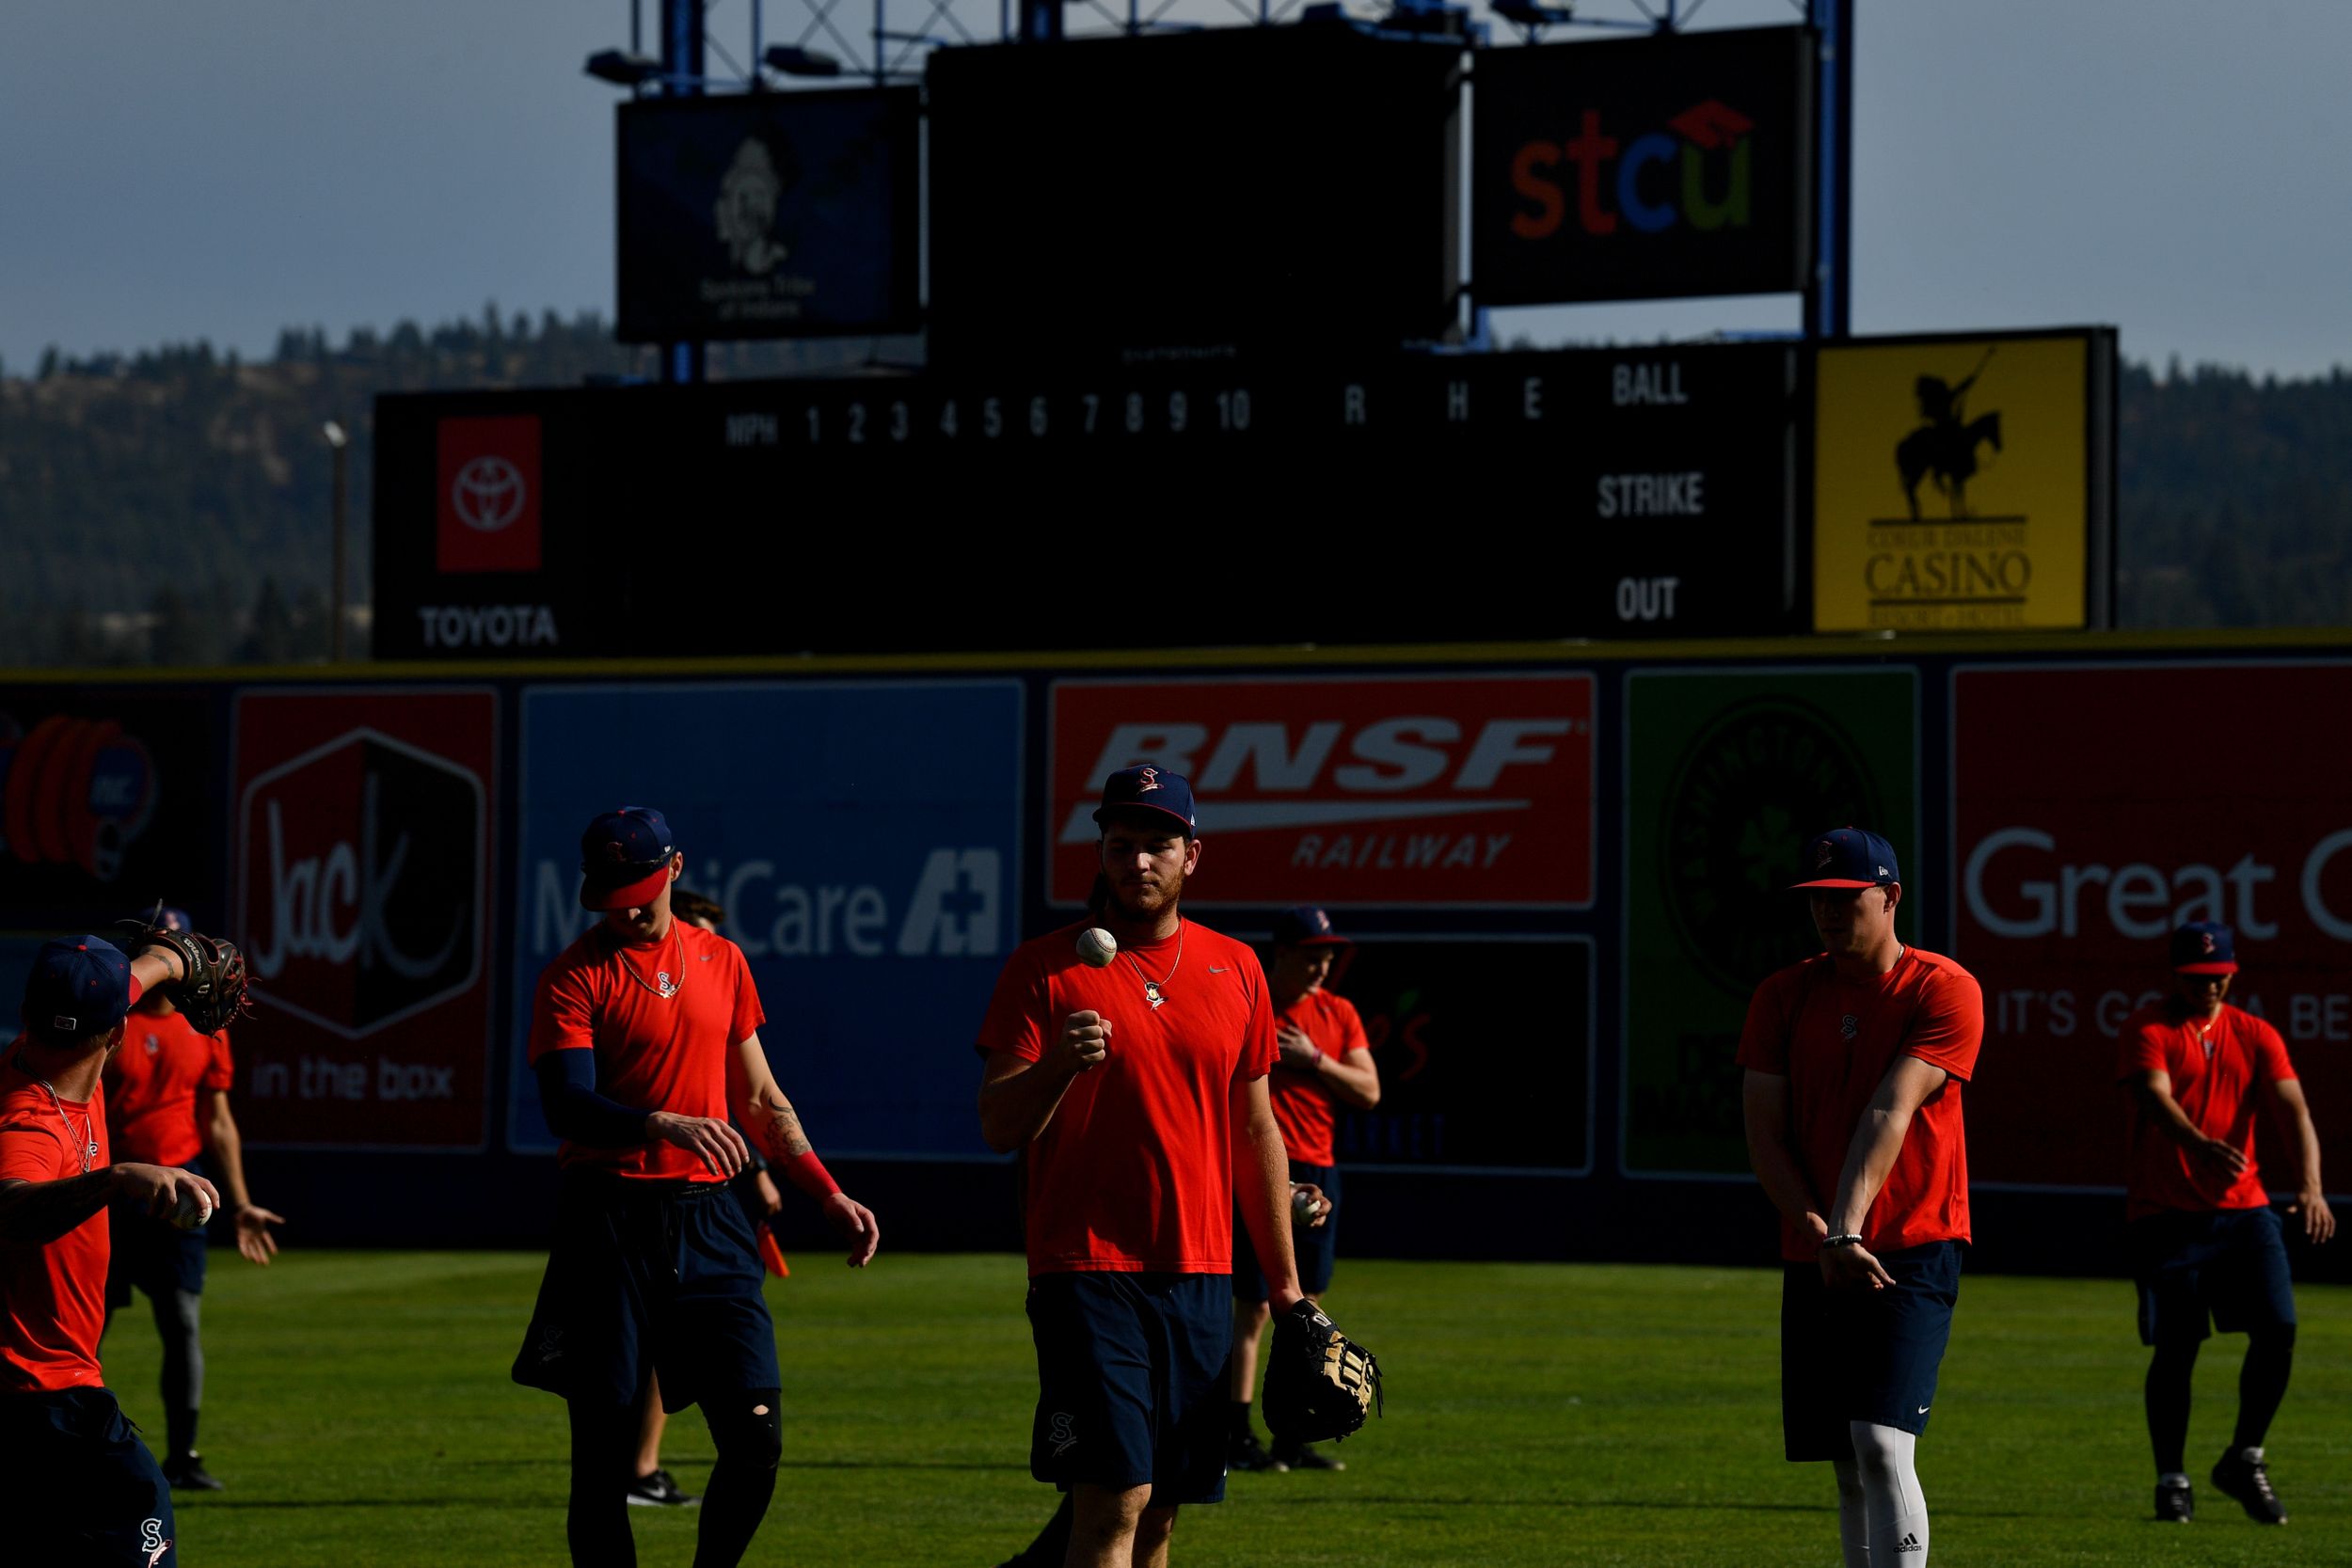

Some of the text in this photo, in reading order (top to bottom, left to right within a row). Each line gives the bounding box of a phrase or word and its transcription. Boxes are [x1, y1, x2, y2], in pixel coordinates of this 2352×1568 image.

[1510, 107, 1754, 241] stcu
[1612, 362, 1690, 407] BALL
[725, 377, 1544, 448] MPH 1 2 3 4 5 6 7 8 9 10 R H E
[1597, 471, 1706, 519] STRIKE
[1865, 549, 2032, 596] CASINO
[1615, 576, 1682, 624] OUT
[417, 604, 559, 649] TOYOTA
[1083, 717, 1576, 793] BNSF
[248, 769, 468, 979] Jack
[1289, 832, 1514, 871] RAILWAY
[532, 858, 888, 957] MiCare
[1963, 825, 2280, 942] Great
[1997, 988, 2078, 1037] IT'S
[250, 1054, 455, 1101] in the box
[1893, 1544, 1922, 1554] adidas
